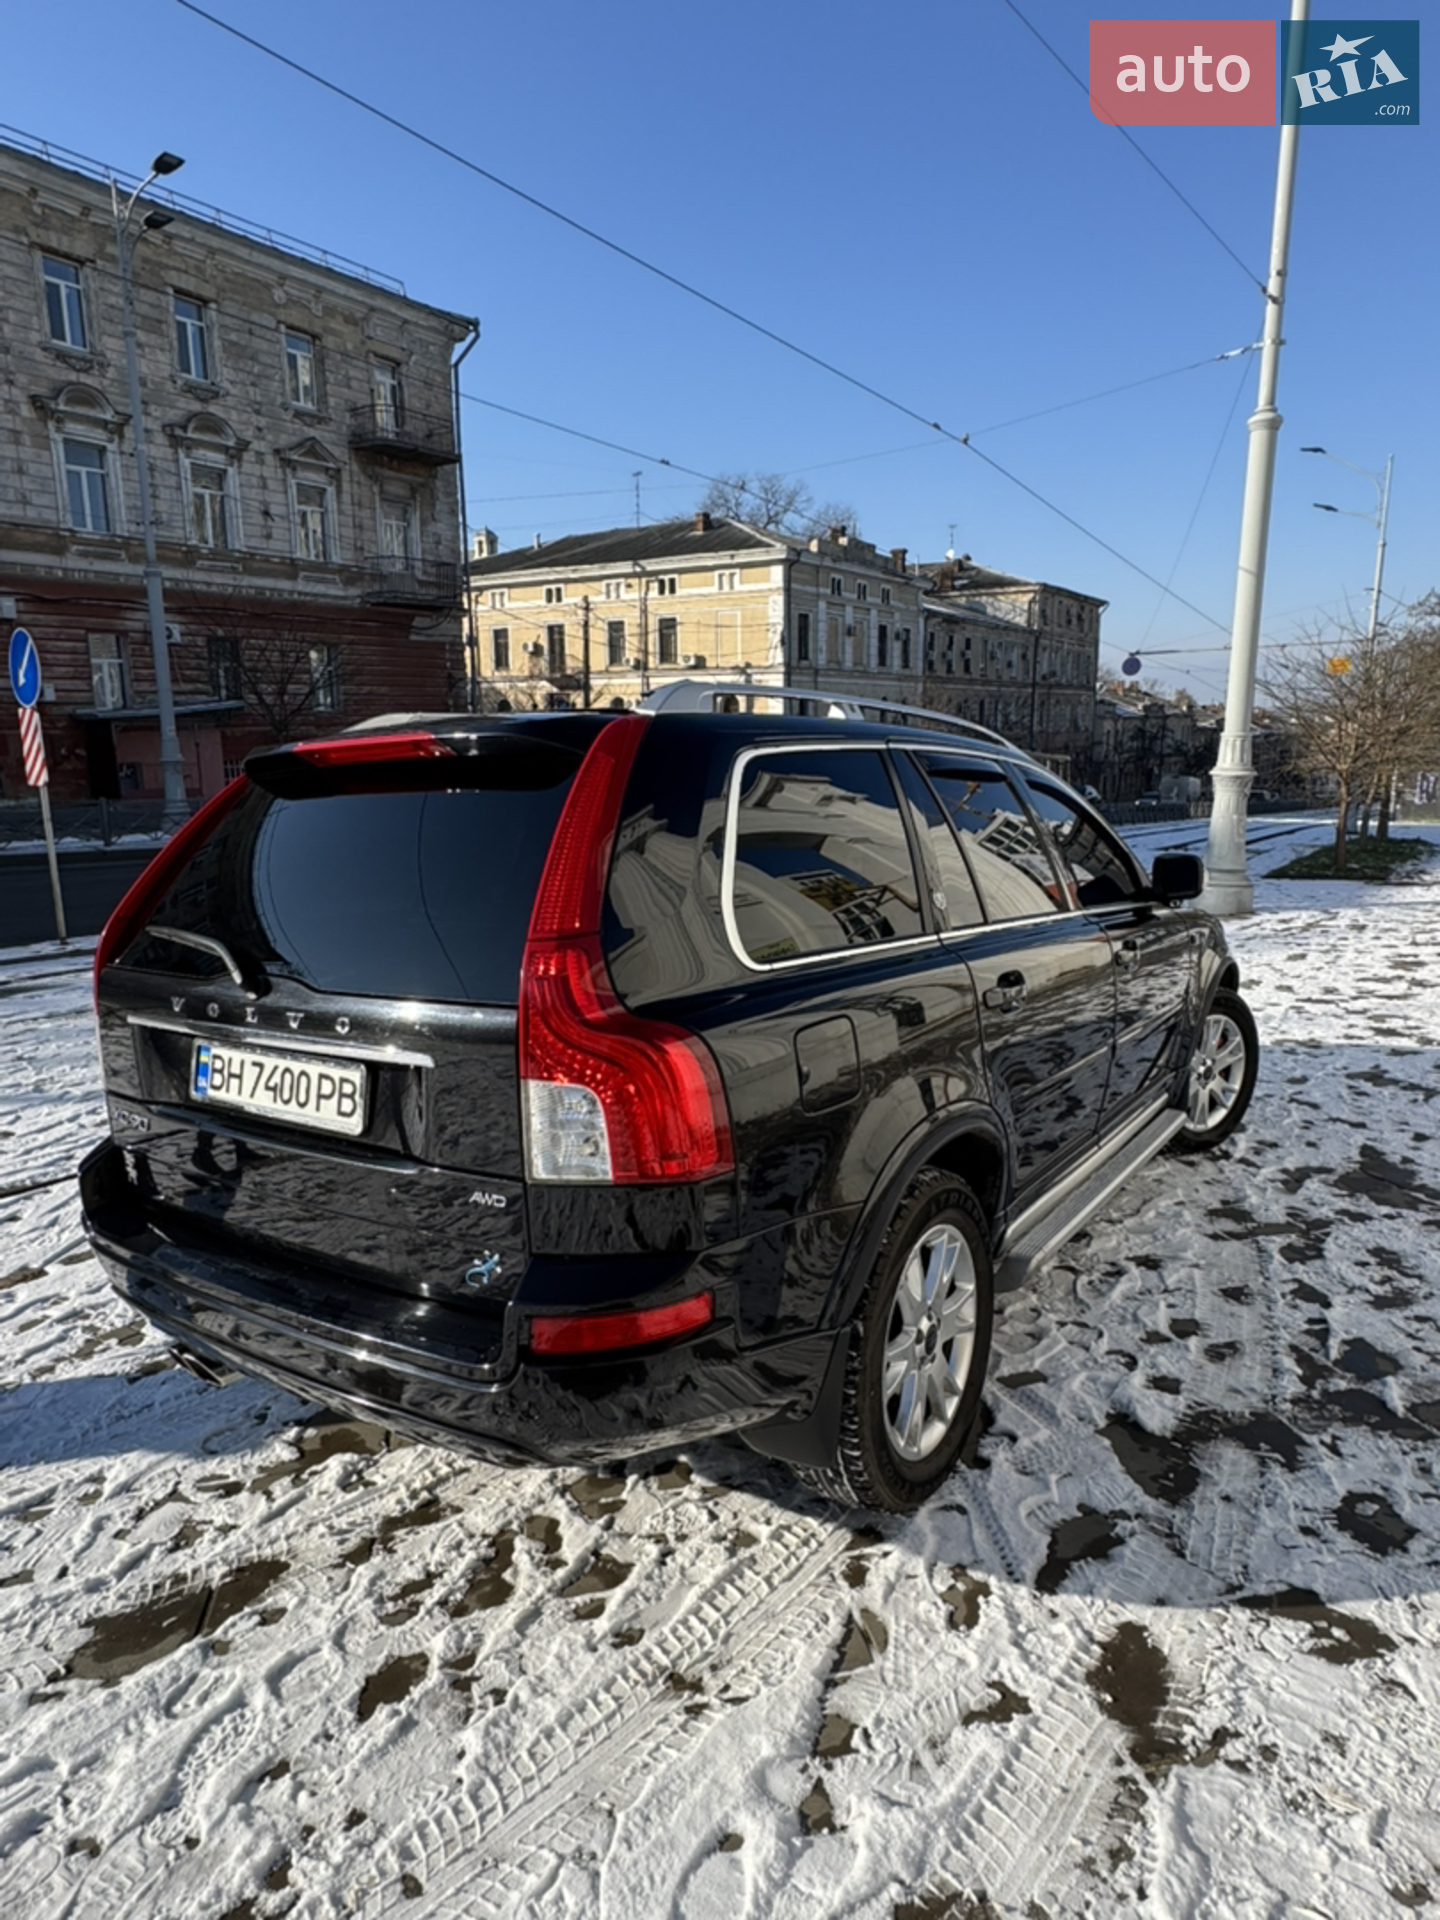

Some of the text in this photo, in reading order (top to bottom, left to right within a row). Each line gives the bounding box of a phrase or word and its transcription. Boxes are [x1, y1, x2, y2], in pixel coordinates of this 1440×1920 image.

[171, 997, 350, 1035] VOLVO
[210, 1054, 358, 1118] BH 7400 PB
[469, 1191, 507, 1208] AWD
